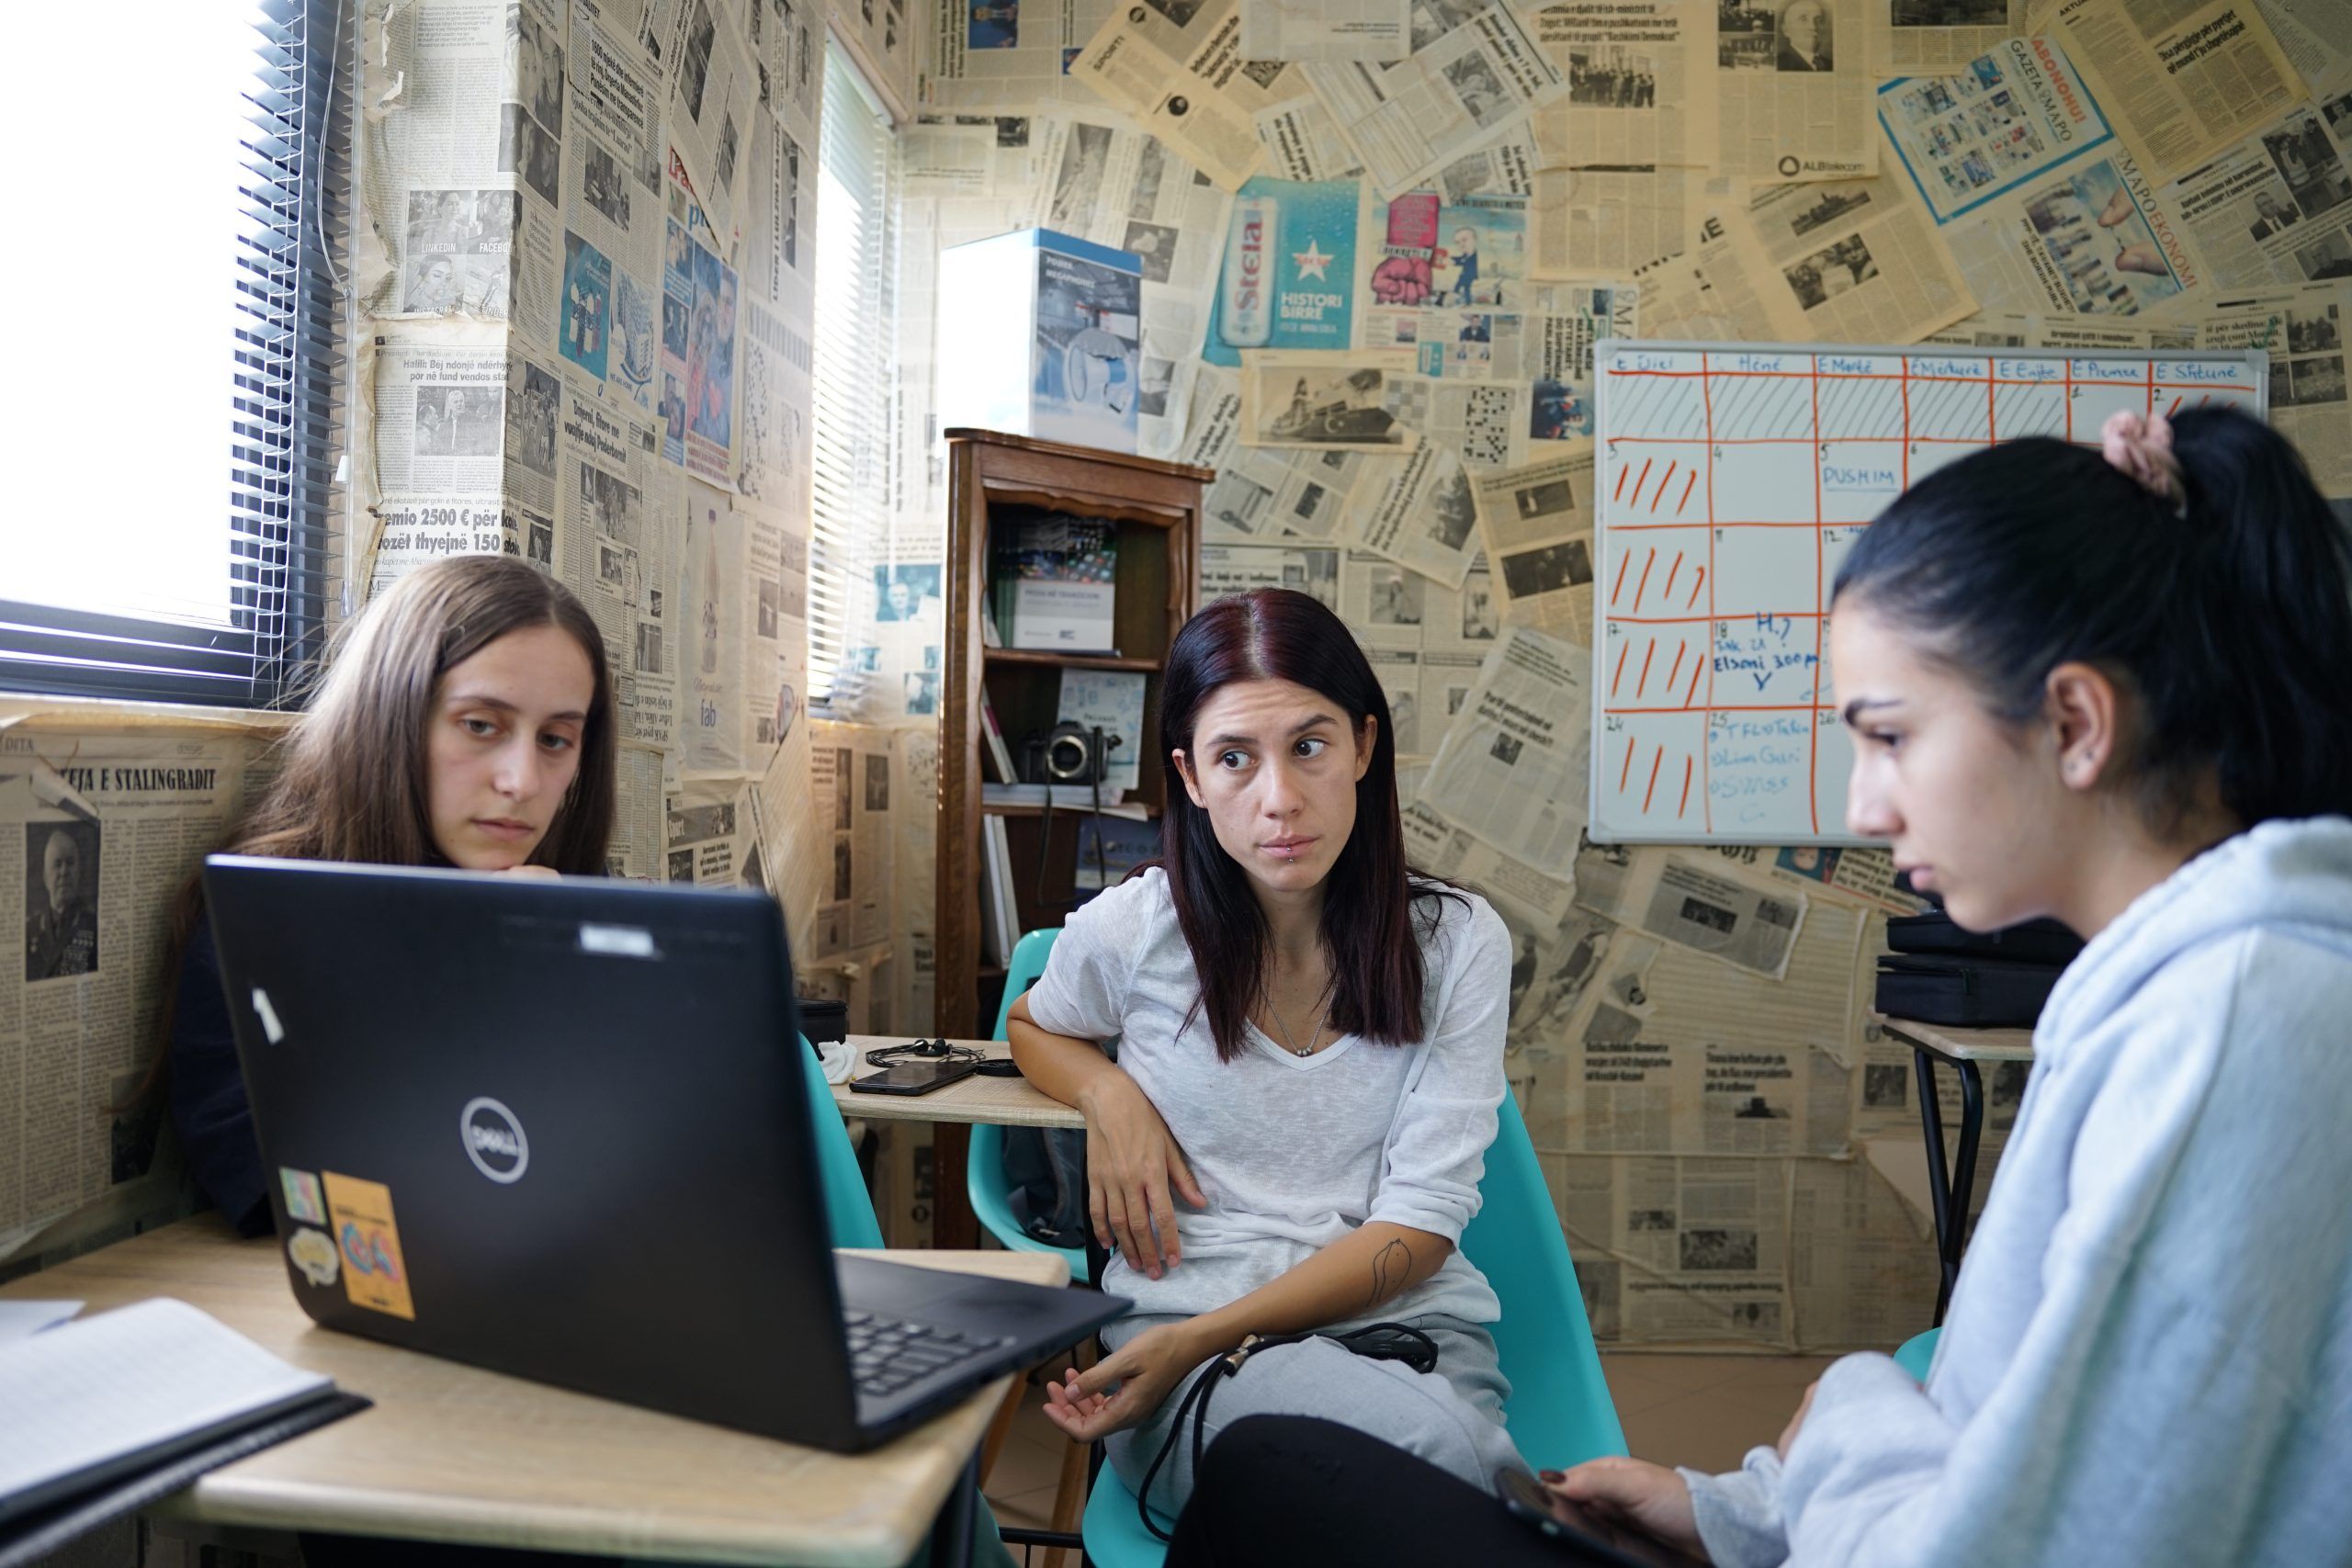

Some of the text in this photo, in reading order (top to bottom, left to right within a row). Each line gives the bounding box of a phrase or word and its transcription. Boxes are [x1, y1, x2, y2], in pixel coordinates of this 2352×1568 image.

[2030, 38, 2086, 124] ABONOHU!
[2007, 38, 2075, 143] GAZETA MAPO
[2118, 158, 2199, 289] MAPO EKONOMI
[421, 243, 457, 254] LINKEDIN
[1234, 217, 1264, 310] Stela
[1281, 293, 1341, 308] HISTORI
[481, 307, 508, 318] TINDER
[403, 359, 475, 371] Halili: Bëj ndonjë
[410, 371, 490, 382] por në fund vendos
[2154, 388, 2166, 402] 2
[1821, 445, 1830, 460] 5
[1823, 467, 1894, 485] PUSHIM
[382, 507, 498, 530] remio 2500 € për
[415, 532, 500, 554] thyejnë 150
[1823, 529, 1841, 542] 12
[1714, 621, 1728, 638] 18
[700, 700, 717, 727] fab
[1711, 711, 1728, 728] 25
[1608, 716, 1623, 732] 24
[101, 767, 216, 791] E STALINGRADIT
